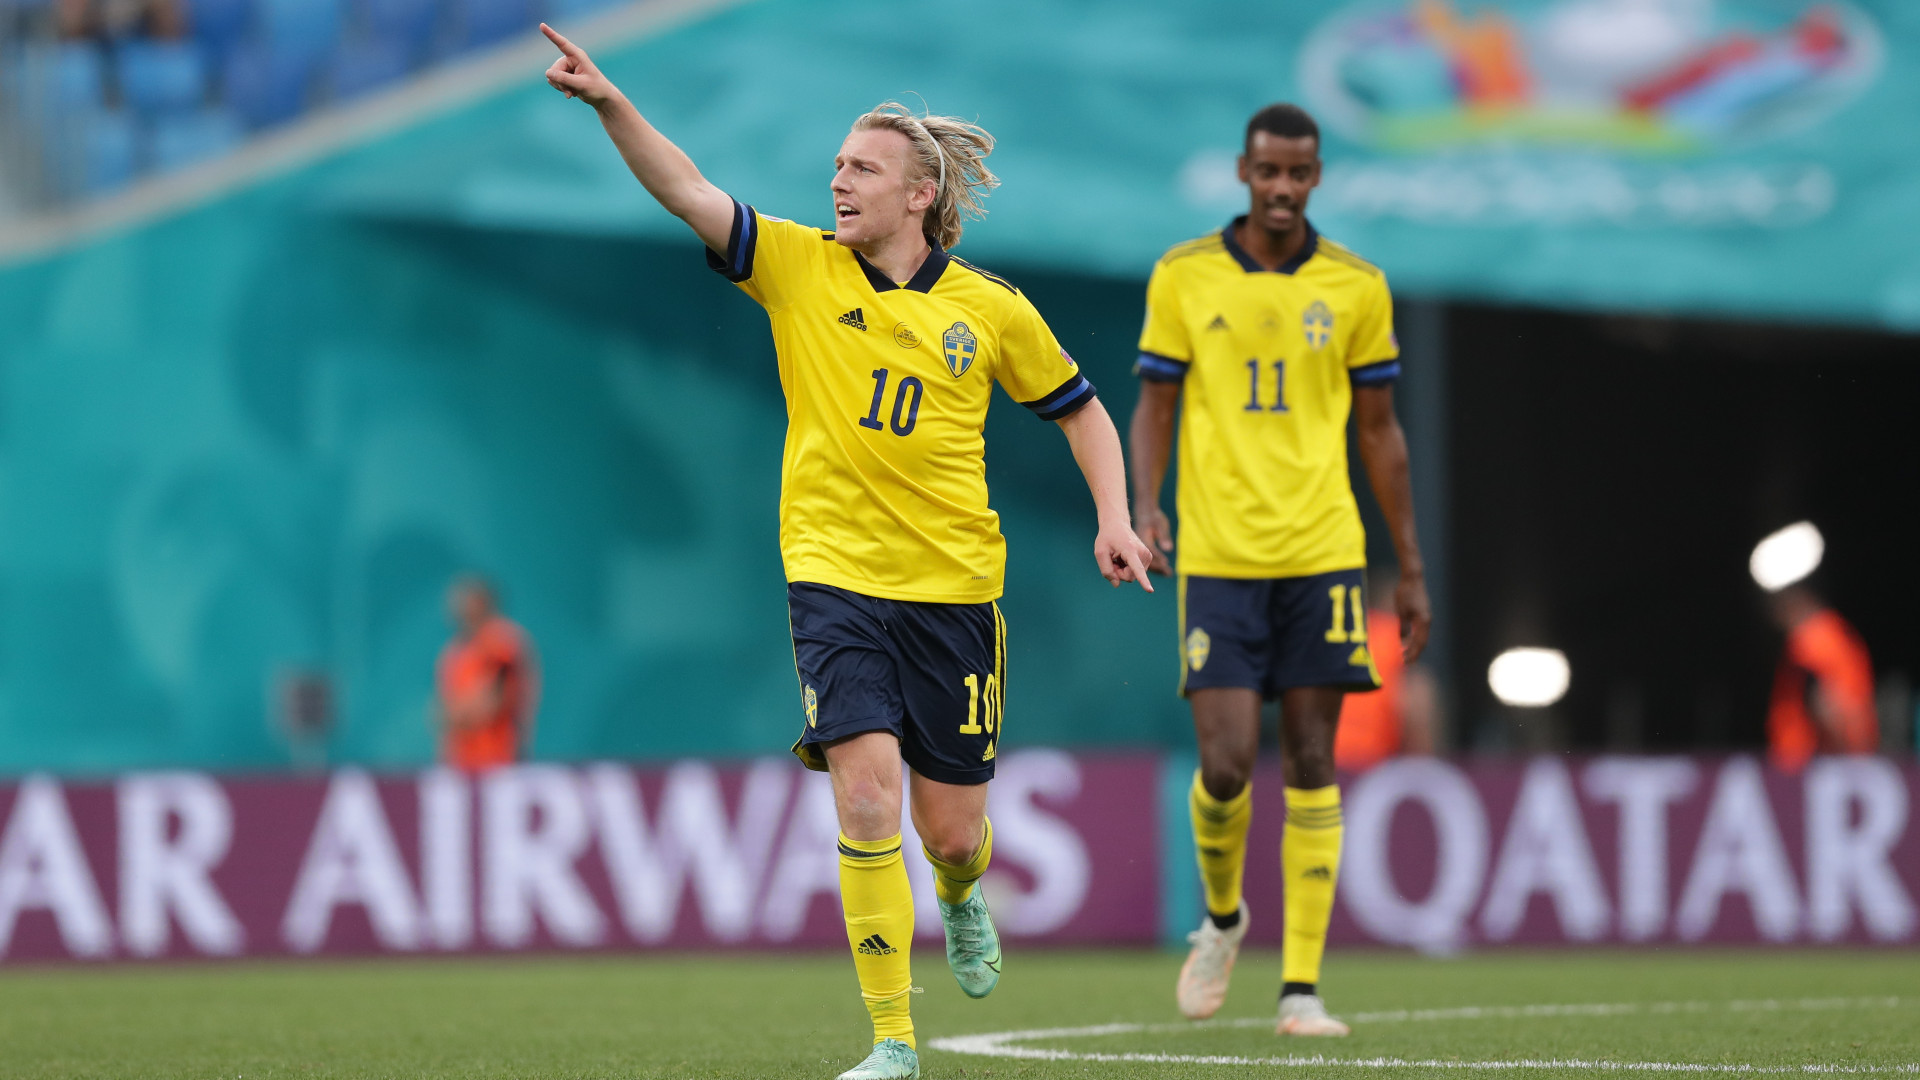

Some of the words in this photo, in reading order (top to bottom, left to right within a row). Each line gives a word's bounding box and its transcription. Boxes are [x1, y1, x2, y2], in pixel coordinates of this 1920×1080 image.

[838, 316, 867, 332] adidas
[859, 368, 923, 436] 10
[1244, 358, 1289, 412] 11
[1324, 584, 1367, 643] 11
[959, 673, 995, 734] 10
[0, 772, 246, 957] AR
[281, 749, 1090, 953] AIRWAS
[1339, 755, 1915, 957] QATAR
[858, 946, 898, 956] adidas
